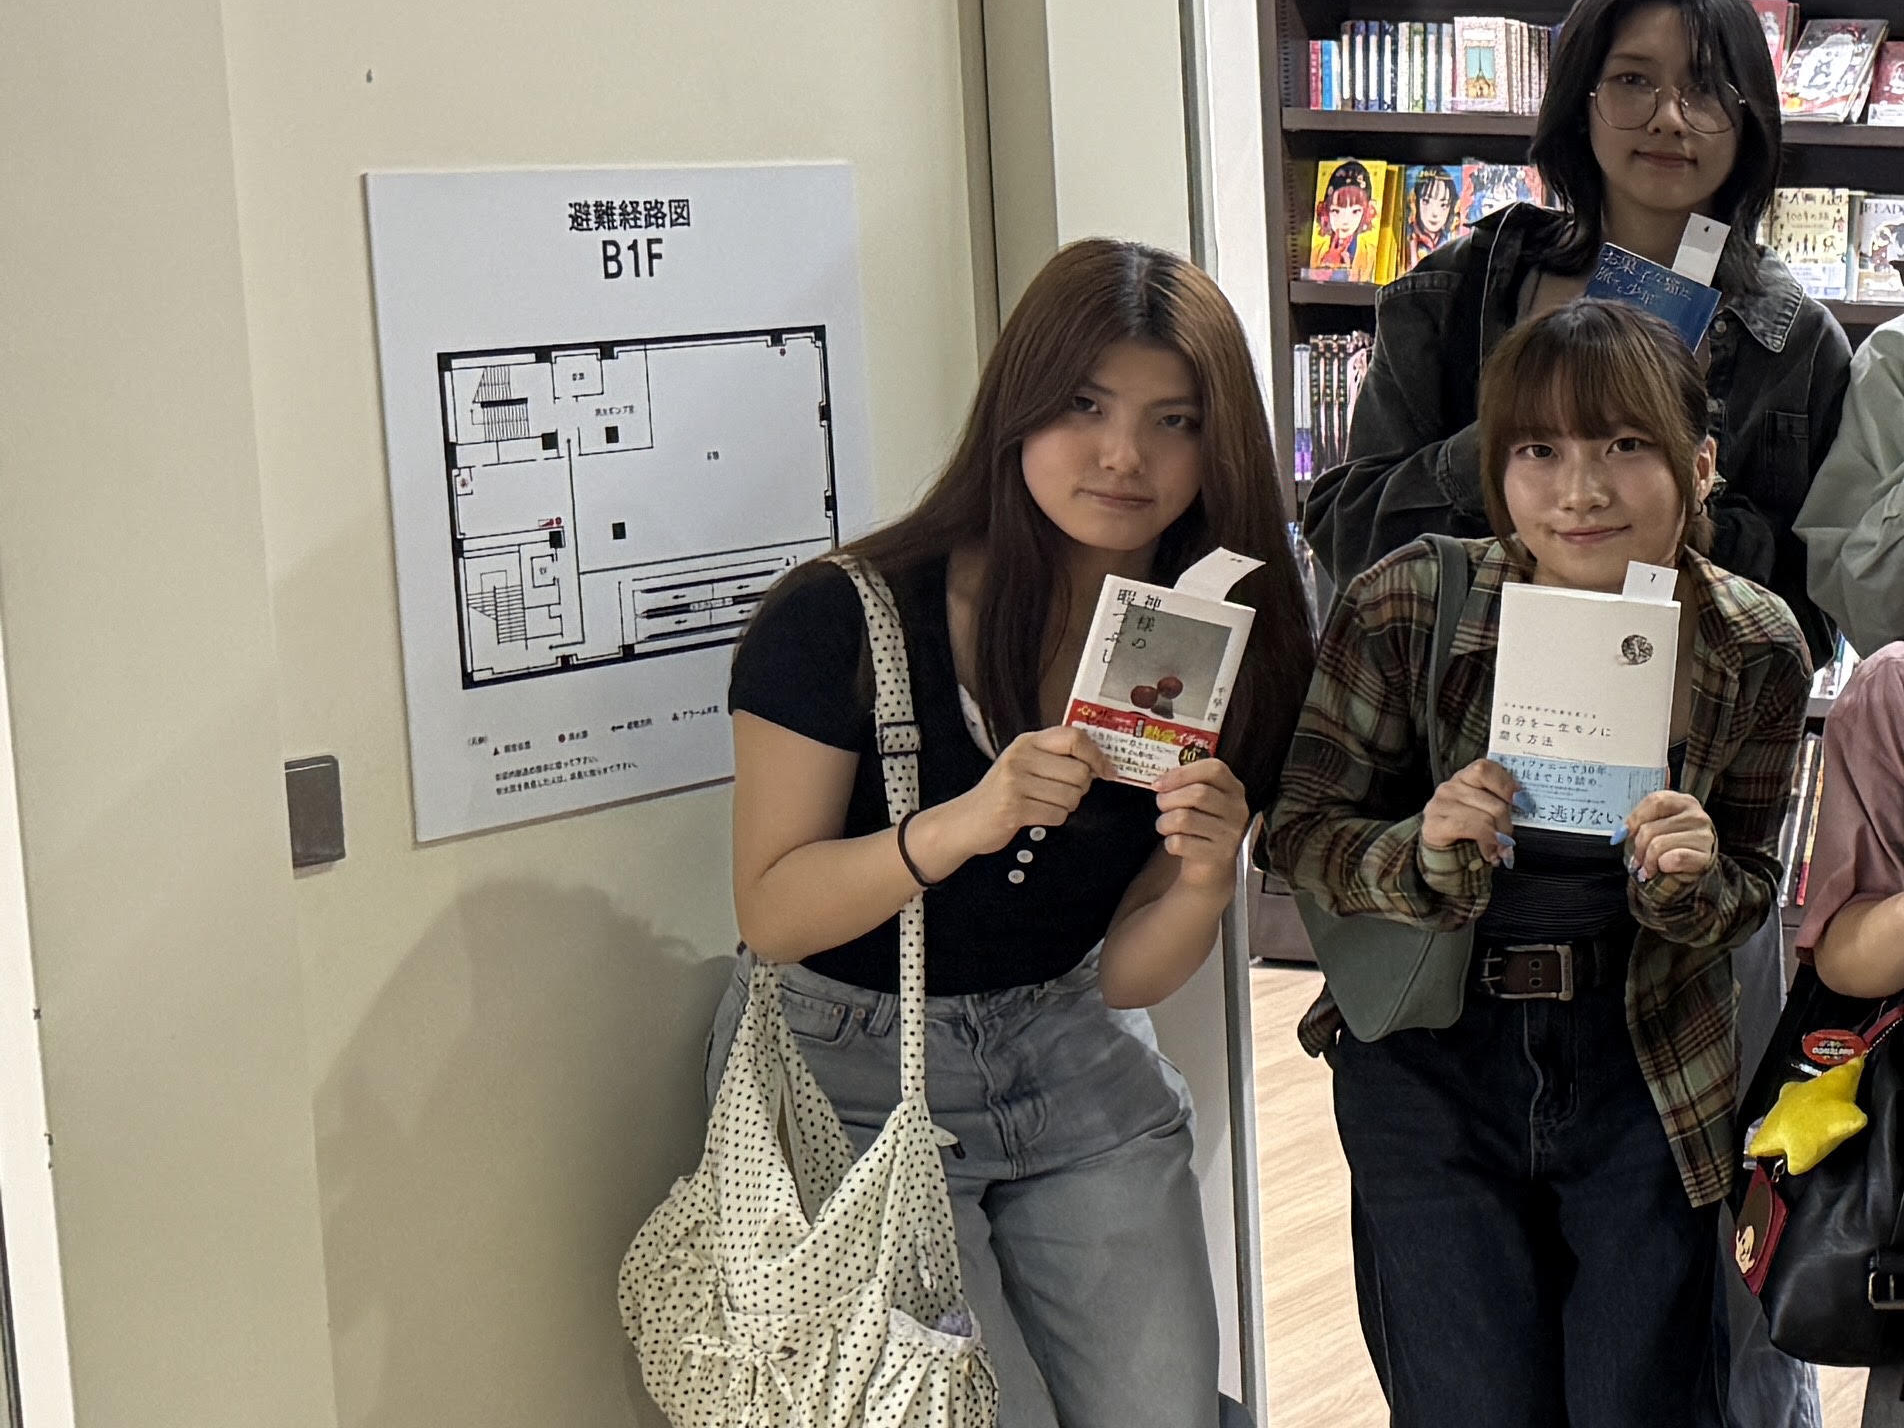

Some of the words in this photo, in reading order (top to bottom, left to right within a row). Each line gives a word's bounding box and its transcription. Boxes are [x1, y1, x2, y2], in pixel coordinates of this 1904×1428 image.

[567, 199, 691, 232] 避難経路図
[601, 239, 663, 279] B1F
[1501, 714, 1611, 737] 自分を一生モノに
